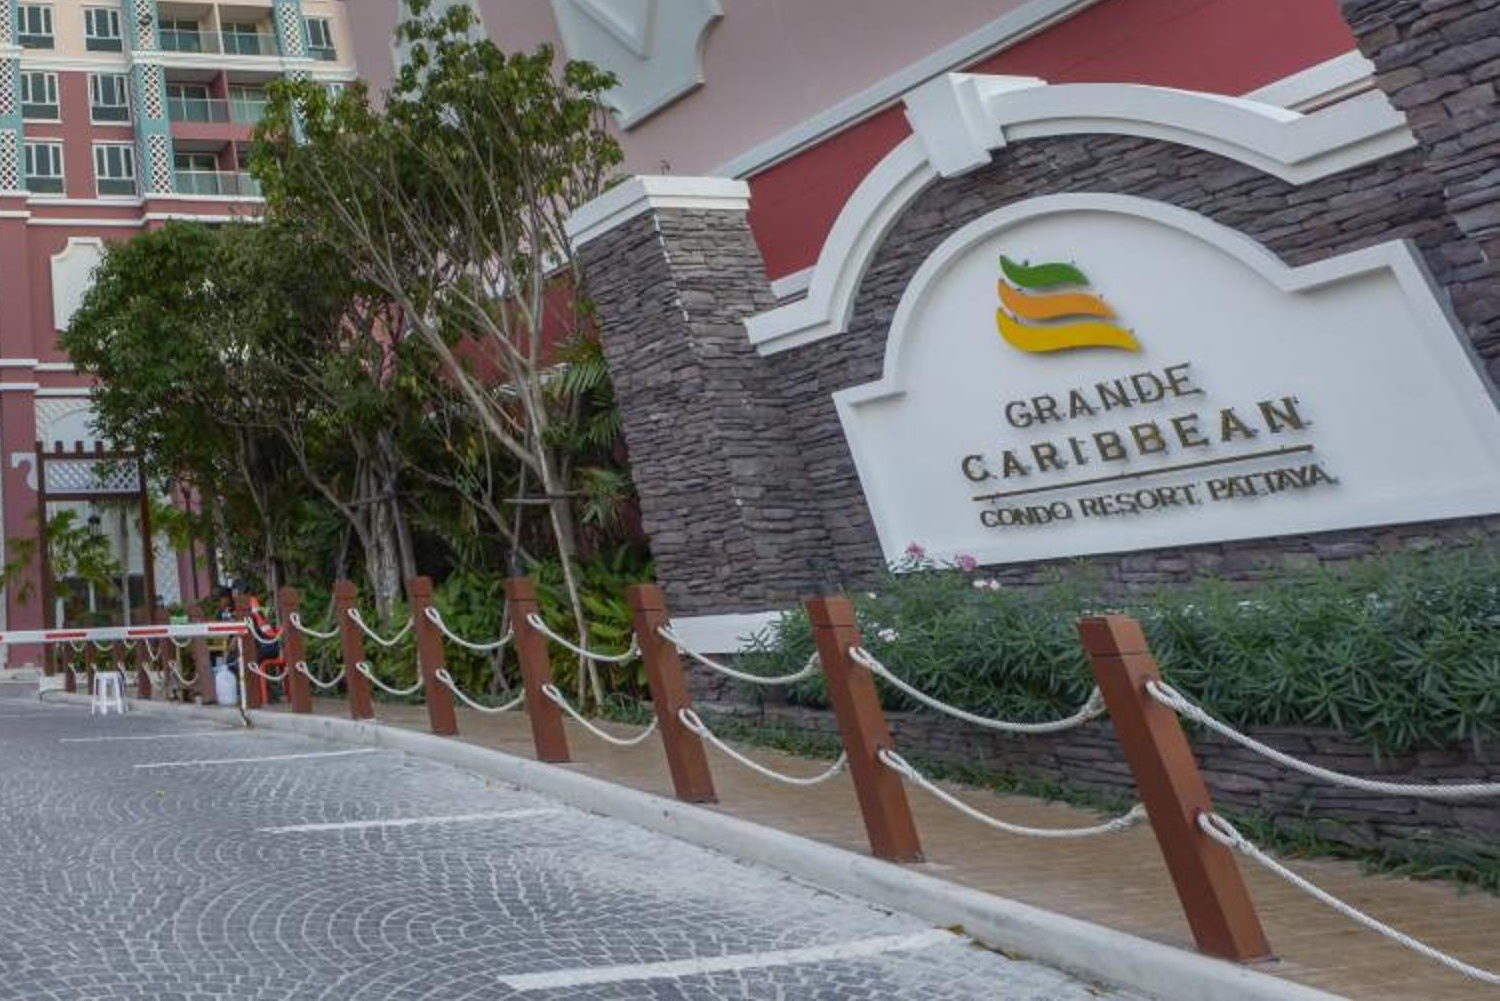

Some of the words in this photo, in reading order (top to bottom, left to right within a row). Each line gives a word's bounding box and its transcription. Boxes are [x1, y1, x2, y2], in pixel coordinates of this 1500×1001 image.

[1005, 362, 1204, 428] GRANDE
[961, 395, 1311, 483] CARIBBEAN
[980, 501, 1073, 528] CONDO
[1205, 463, 1338, 501] PATTAYA
